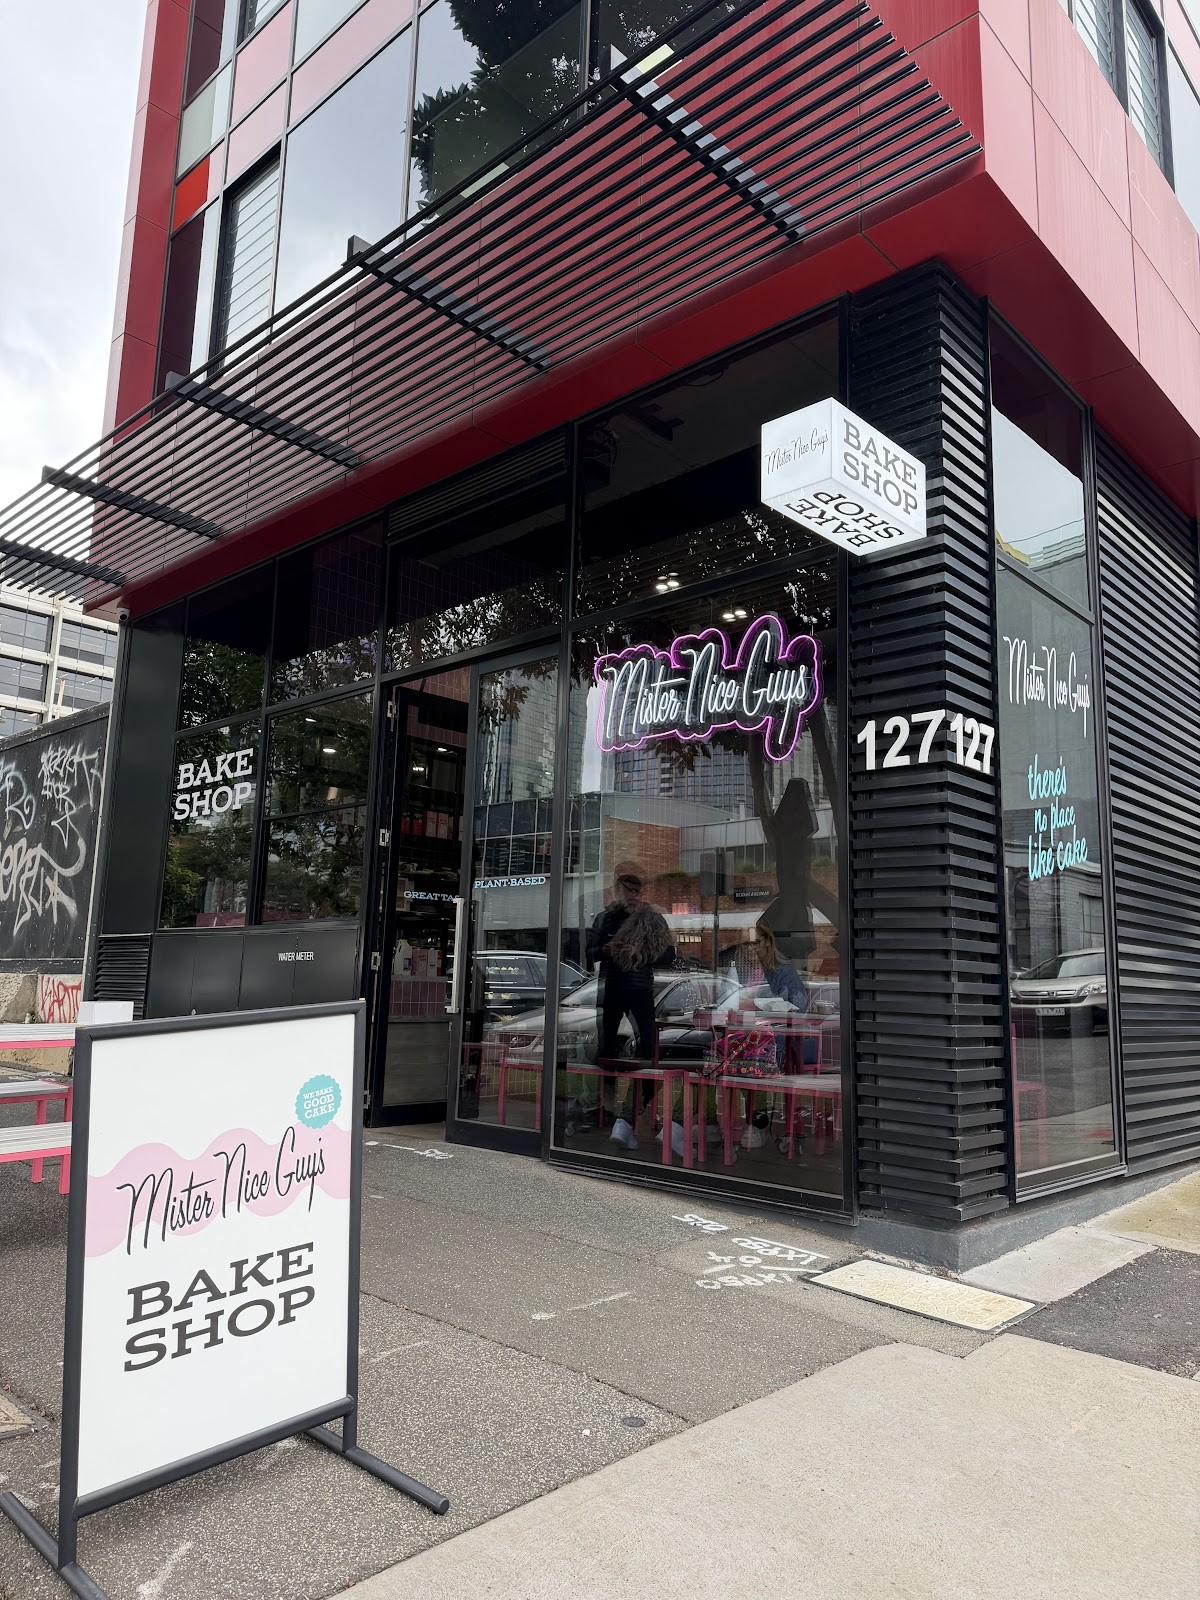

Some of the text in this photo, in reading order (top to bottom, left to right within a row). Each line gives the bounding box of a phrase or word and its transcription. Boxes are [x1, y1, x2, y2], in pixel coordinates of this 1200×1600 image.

[765, 447, 793, 475] Mister
[790, 436, 810, 461] Nice
[843, 418, 917, 490] BAKE
[843, 451, 918, 515] SHOP
[784, 498, 877, 548] BAKE
[812, 491, 905, 540] SHOP
[603, 657, 685, 738] Mister
[681, 642, 739, 725] Nice
[1003, 636, 1046, 705] Mister
[1041, 645, 1068, 709] Nice
[857, 709, 946, 771] 127
[950, 712, 995, 775] 127
[176, 747, 254, 790] BAKE
[1027, 753, 1067, 801] there's
[173, 781, 252, 820] SHOP
[1034, 797, 1076, 847] no place
[1028, 825, 1088, 882] like cake
[403, 890, 440, 901] GREAT
[278, 951, 314, 962] WATER METER
[303, 1086, 334, 1101] WE BAKE
[303, 1094, 334, 1110] GOOD
[304, 1103, 335, 1119] CAKE
[116, 1126, 326, 1255] Mister Nice Guy's
[126, 1241, 314, 1326] BAKE
[123, 1285, 316, 1373] SHOP
